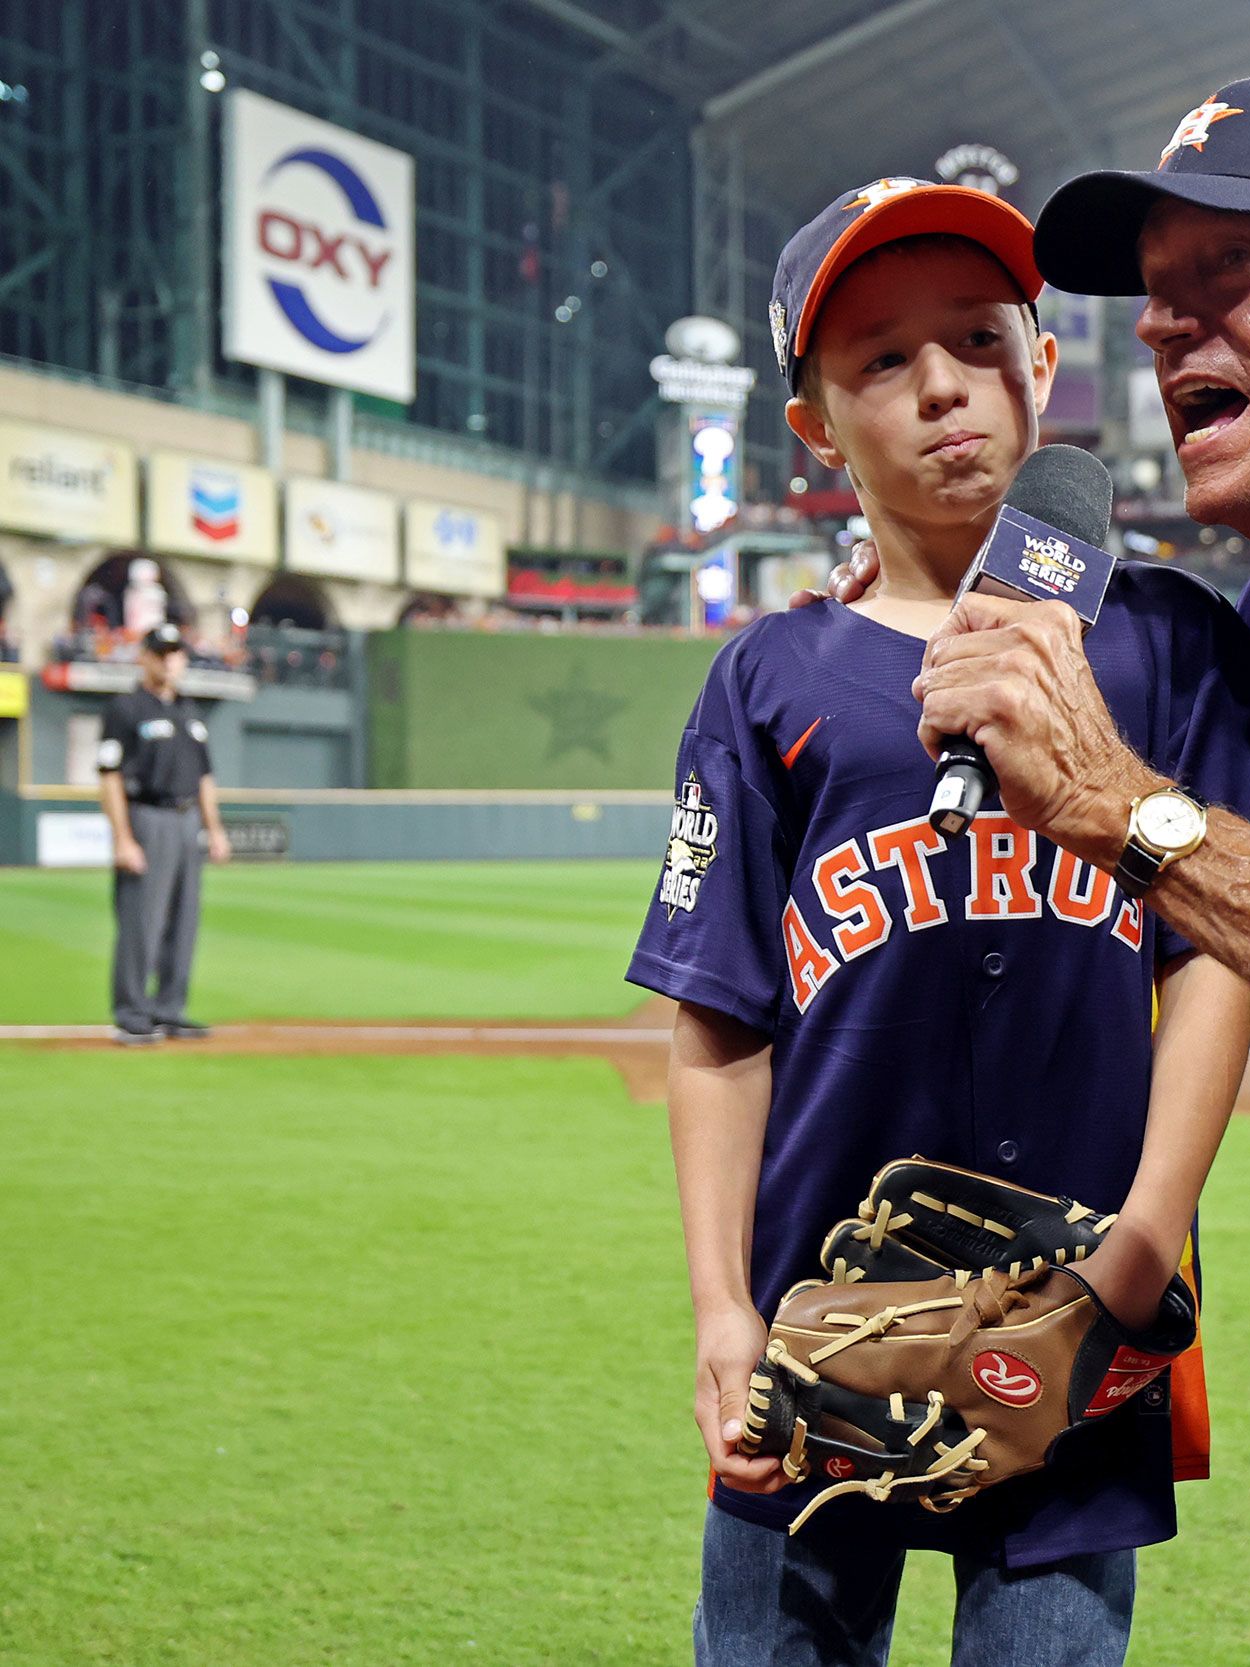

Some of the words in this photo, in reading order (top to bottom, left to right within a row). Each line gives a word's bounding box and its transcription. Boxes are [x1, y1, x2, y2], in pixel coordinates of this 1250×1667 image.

[257, 209, 391, 289] OXY
[7, 453, 107, 498] reliant
[1024, 534, 1087, 573] WORLD
[1018, 558, 1078, 593] SERIES
